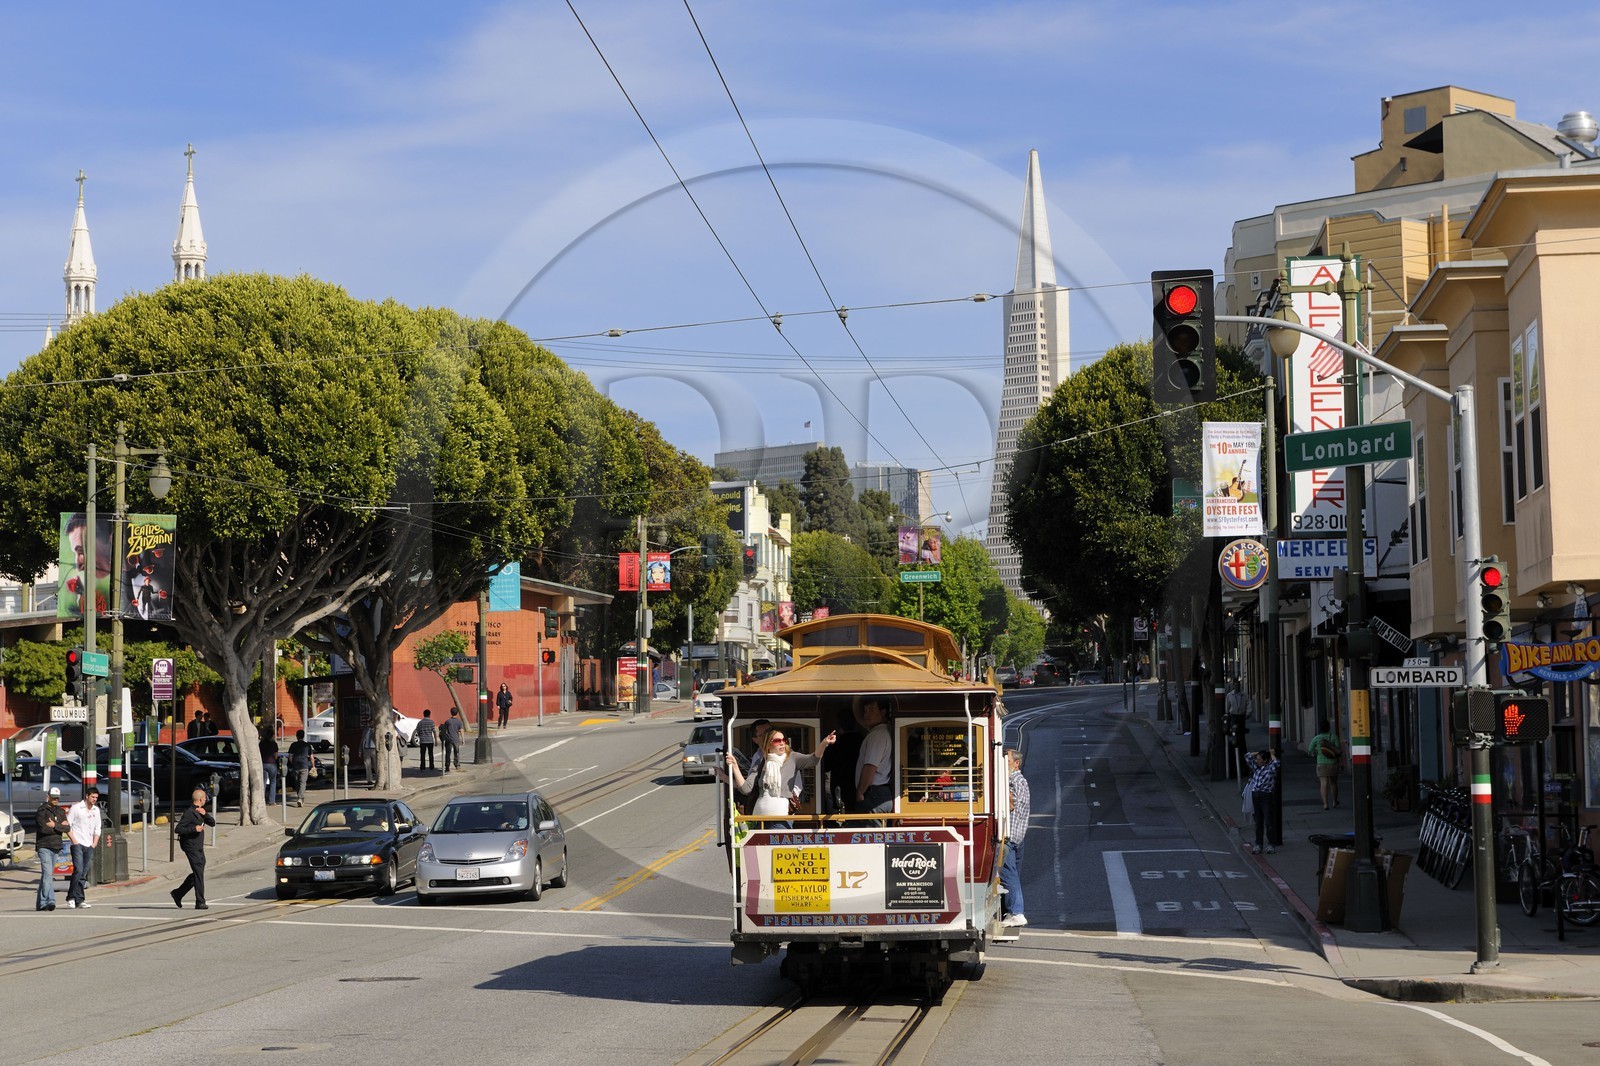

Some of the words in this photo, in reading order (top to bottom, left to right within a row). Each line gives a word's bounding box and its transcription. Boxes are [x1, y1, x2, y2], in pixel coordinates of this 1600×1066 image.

[1301, 432, 1395, 462] Lombard
[720, 490, 741, 499] could
[1206, 505, 1237, 515] OYSTER
[1238, 505, 1258, 515] FEST
[1278, 539, 1375, 557] MERCEDS
[1223, 545, 1240, 567] ALFA
[1240, 542, 1267, 566] ROMEO
[1295, 565, 1349, 577] SERV
[470, 621, 502, 629] FRISCO
[1384, 629, 1412, 652] STUDIO
[1506, 643, 1551, 673] BIKE
[1552, 644, 1573, 662] AND
[1376, 670, 1458, 684] LOMBARD
[1538, 668, 1567, 680] RENTALS
[1574, 665, 1594, 678] TOURS
[53, 709, 86, 718] COLUMBUS
[769, 833, 836, 845] MARKET
[851, 831, 917, 844] STREET
[776, 852, 826, 861] POWELL
[891, 857, 915, 868] Hard
[915, 857, 937, 869] Rock
[775, 867, 827, 875] MARKET
[1139, 870, 1249, 879] STOP
[836, 870, 869, 889] 17
[776, 885, 790, 893] BAY
[799, 884, 828, 893] TAYLOR
[1155, 900, 1260, 912] BUS
[763, 913, 869, 927] FISHERMANS
[885, 913, 942, 925] WHARF
